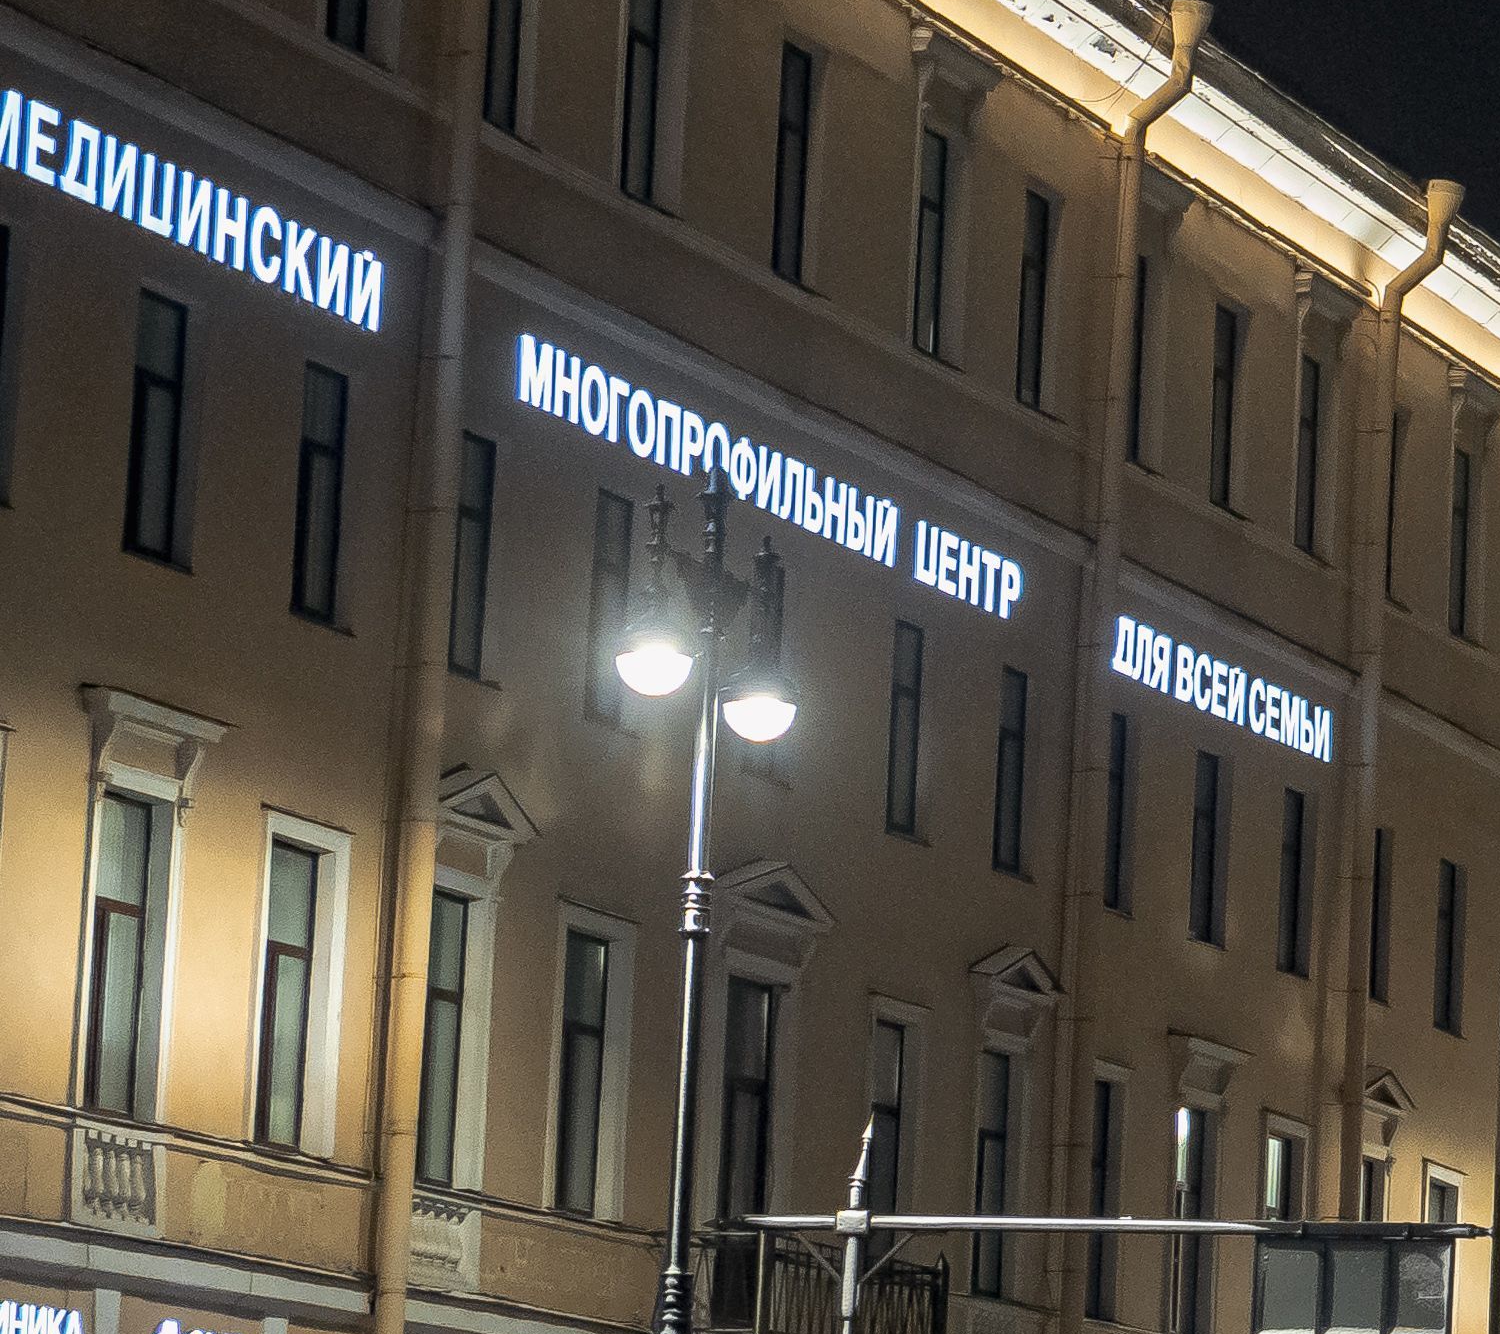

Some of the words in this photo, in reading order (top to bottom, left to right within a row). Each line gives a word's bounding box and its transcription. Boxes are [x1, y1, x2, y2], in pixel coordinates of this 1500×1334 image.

[517, 332, 899, 569] МНОГОПРОФИЛЬНЫЙ
[912, 519, 1022, 620] ЦЕНТР
[1111, 615, 1172, 694] ДЛЯ
[1173, 643, 1247, 727] ВСЕЙ
[1247, 677, 1332, 764] СЕМЬИ
